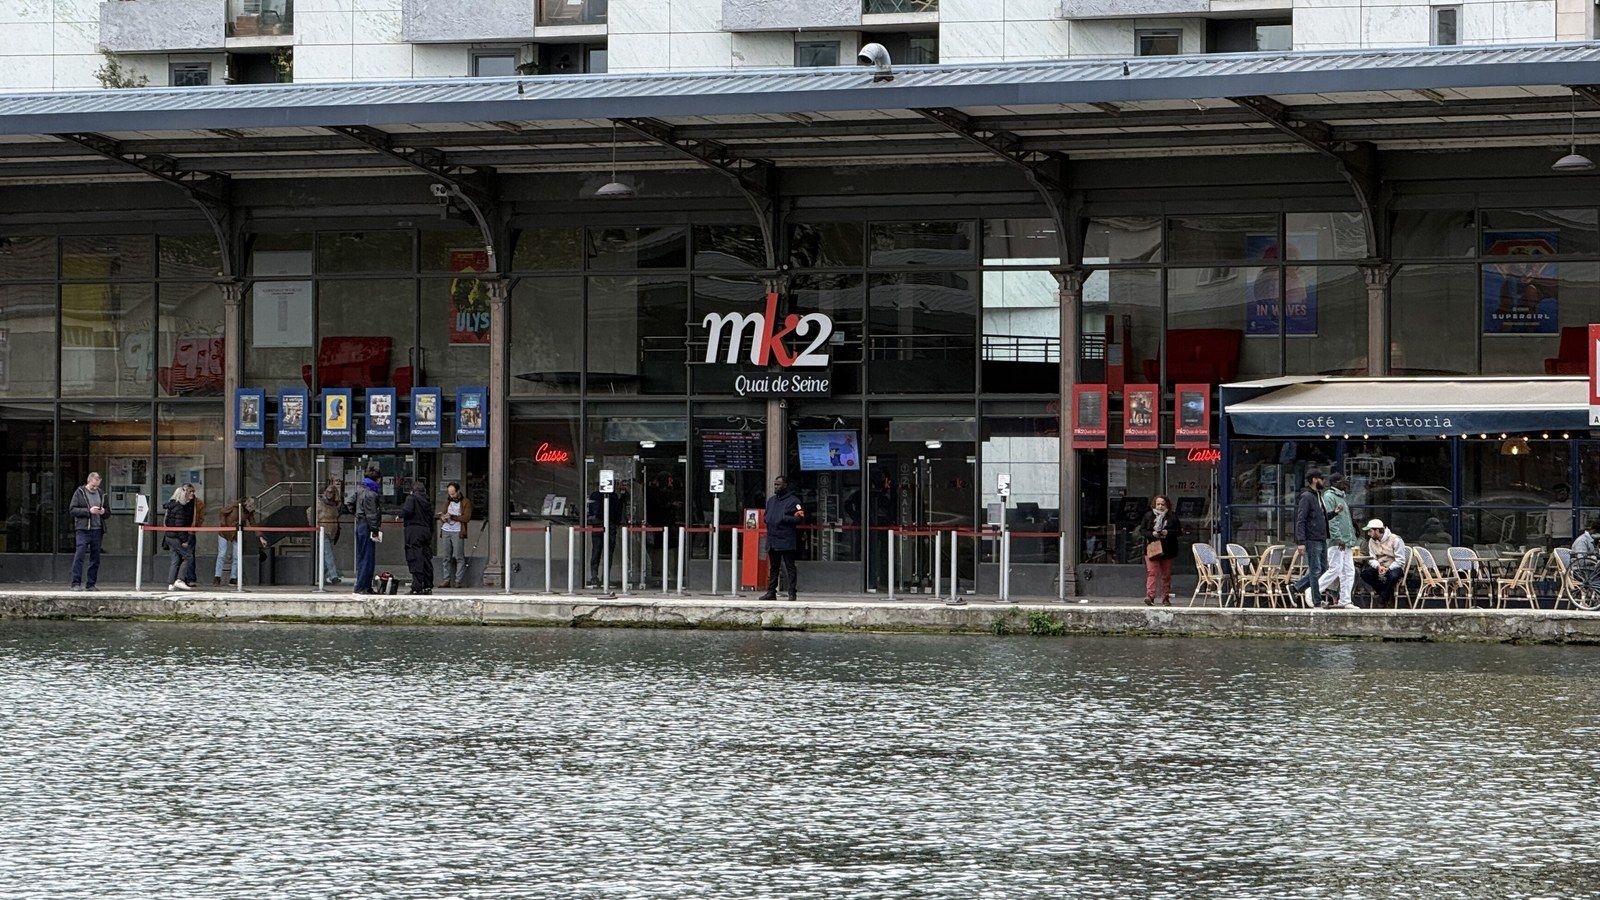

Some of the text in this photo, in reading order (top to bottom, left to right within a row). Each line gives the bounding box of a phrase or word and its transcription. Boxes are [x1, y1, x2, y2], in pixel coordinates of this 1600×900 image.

[1257, 304, 1268, 316] IN
[456, 311, 490, 332] ULYS
[702, 292, 833, 367] mk2
[735, 374, 829, 396] Quai de Seine
[1297, 416, 1336, 428] café
[1364, 415, 1453, 428] trattoria
[535, 442, 568, 462] Caisse
